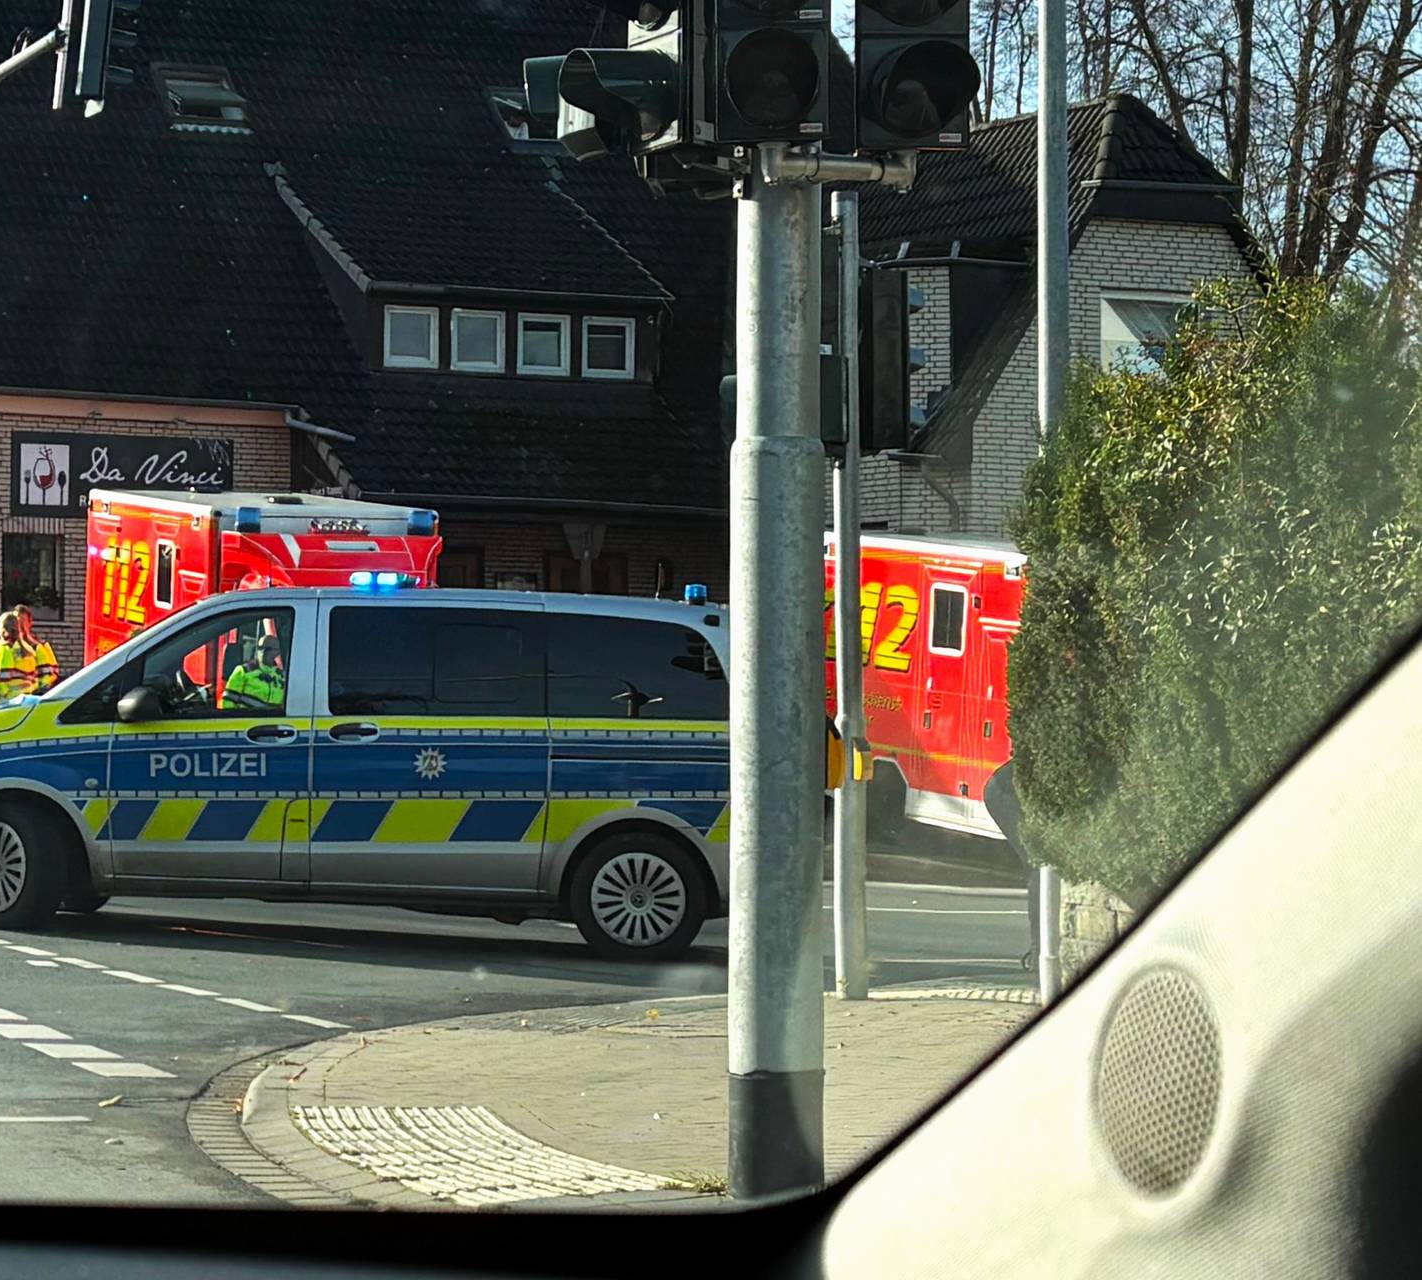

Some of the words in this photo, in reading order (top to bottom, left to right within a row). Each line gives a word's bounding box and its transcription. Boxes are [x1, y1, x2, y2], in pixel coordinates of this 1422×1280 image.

[80, 446, 125, 484] Da
[134, 450, 223, 485] Vinci
[102, 537, 150, 626] 112
[149, 752, 267, 777] POLIZEI
